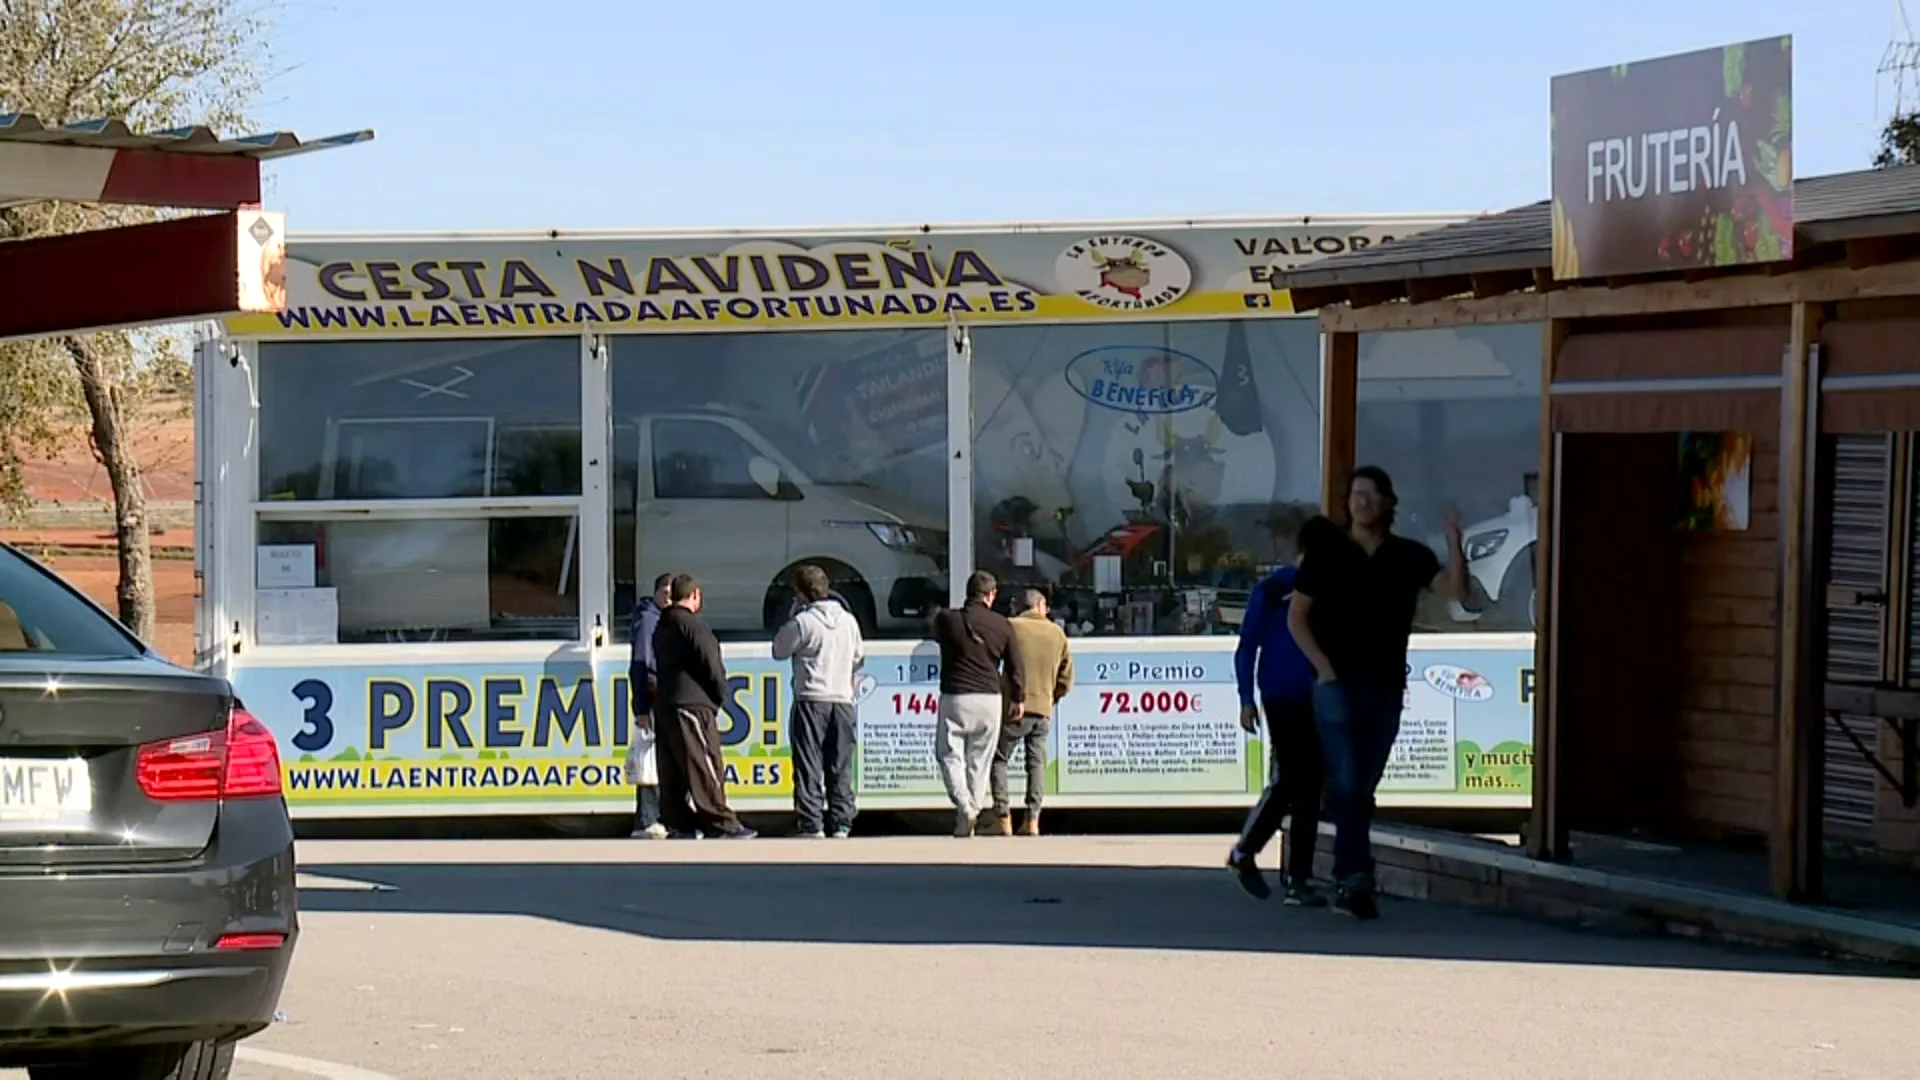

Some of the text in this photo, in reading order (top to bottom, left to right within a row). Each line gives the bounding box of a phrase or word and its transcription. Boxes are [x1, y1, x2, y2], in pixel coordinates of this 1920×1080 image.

[1587, 107, 1747, 203] FRUTERÍA
[318, 239, 1002, 302] CESTA NAVIDEÑA
[277, 290, 1037, 328] WWW.LAENTRADAAFORTUNADA.ES
[1129, 660, 1205, 680] Premio
[291, 676, 778, 751] 3 PREMIS!
[892, 692, 938, 714] 144
[1100, 690, 1203, 713] 72.000€
[1465, 753, 1476, 769] y
[1482, 750, 1535, 765] much
[2, 765, 73, 805] MFW
[290, 764, 780, 788] WWW.LAENTRADAAFORA.ES
